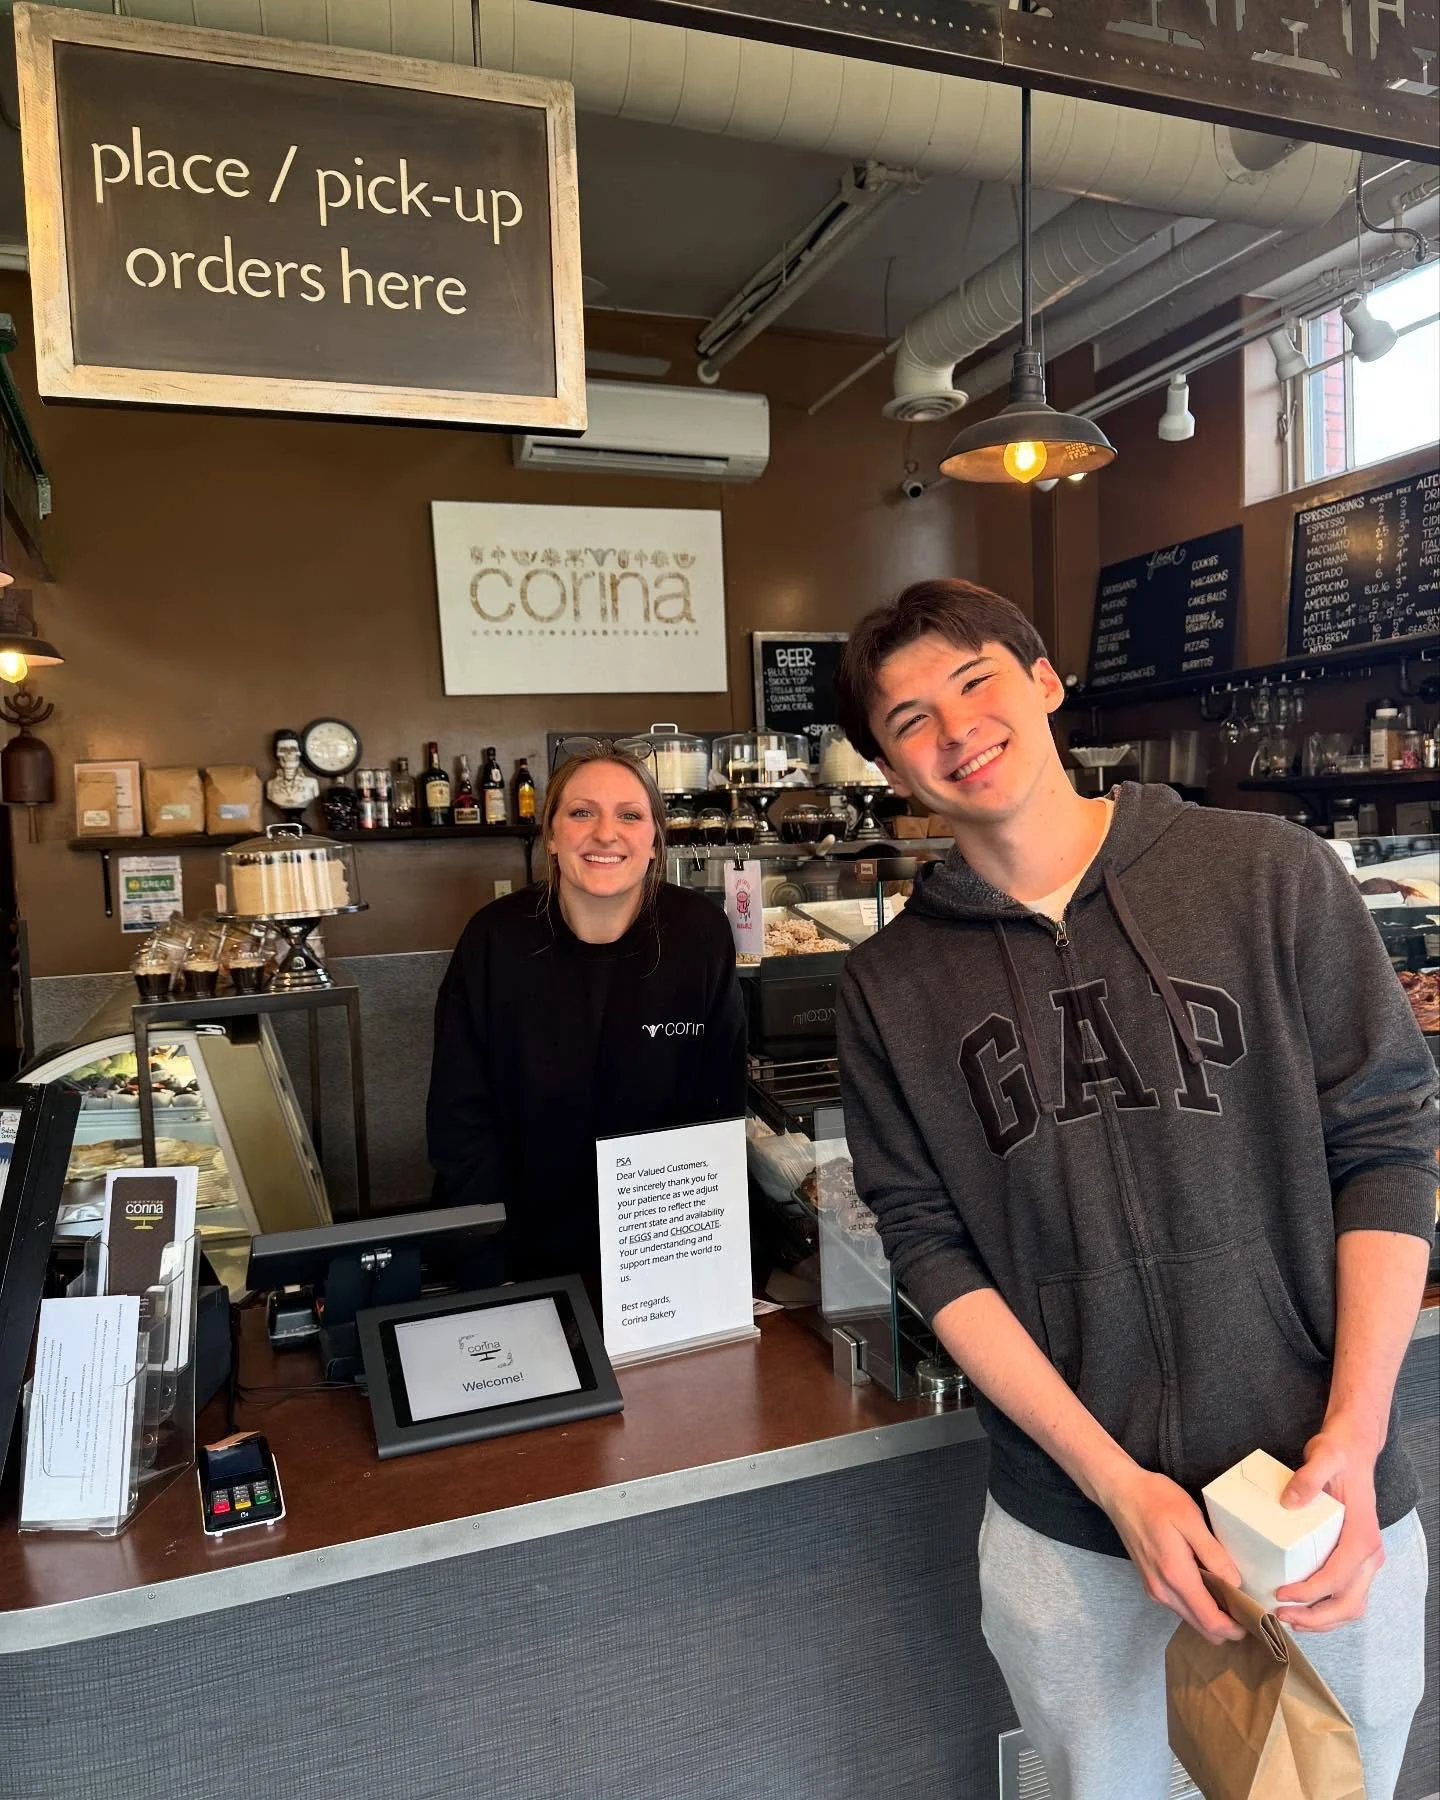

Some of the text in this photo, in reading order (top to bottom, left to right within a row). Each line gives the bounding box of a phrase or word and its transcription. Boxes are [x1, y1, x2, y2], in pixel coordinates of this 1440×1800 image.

[91, 126, 523, 245] place / pick-up
[125, 235, 467, 315] orders here
[1416, 473, 1440, 491] ALTE
[1306, 516, 1345, 535] ESPRESSO
[1421, 539, 1440, 551] ITAL
[1306, 566, 1343, 585] CORTADO
[469, 567, 697, 624] corina
[1304, 592, 1350, 611] AMERICANO
[1304, 609, 1332, 625] LATTE
[1304, 622, 1332, 637] MOCHA
[776, 648, 816, 667] BEER
[767, 667, 813, 677] BLUE MOON
[958, 976, 1247, 1160] GAP
[616, 1157, 632, 1167] PSA
[616, 1161, 708, 1181] Dear Valued Customers,
[617, 1187, 631, 1195] We
[633, 1181, 666, 1193] sincerely
[668, 1177, 690, 1187] thank
[691, 1175, 706, 1185] you
[618, 1198, 636, 1210] your
[638, 1193, 671, 1206] patience
[696, 1185, 719, 1195] adjust
[126, 1203, 163, 1214] corina
[618, 1212, 632, 1220] our
[634, 1208, 657, 1219] prices
[668, 1201, 692, 1211] reflect
[693, 1199, 706, 1207] the
[619, 1208, 725, 1232] current state and availability
[619, 1220, 722, 1245] of EGGS and CHOCOLATE.
[620, 1233, 713, 1257] Your understanding and
[620, 1258, 651, 1270] support
[652, 1254, 674, 1264] mean
[676, 1251, 689, 1260] the
[690, 1245, 713, 1256] world
[621, 1295, 671, 1312] Best regards,
[622, 1309, 676, 1326] Corina Bakery
[467, 1341, 501, 1353] corina
[462, 1372, 525, 1392] Welcome!
